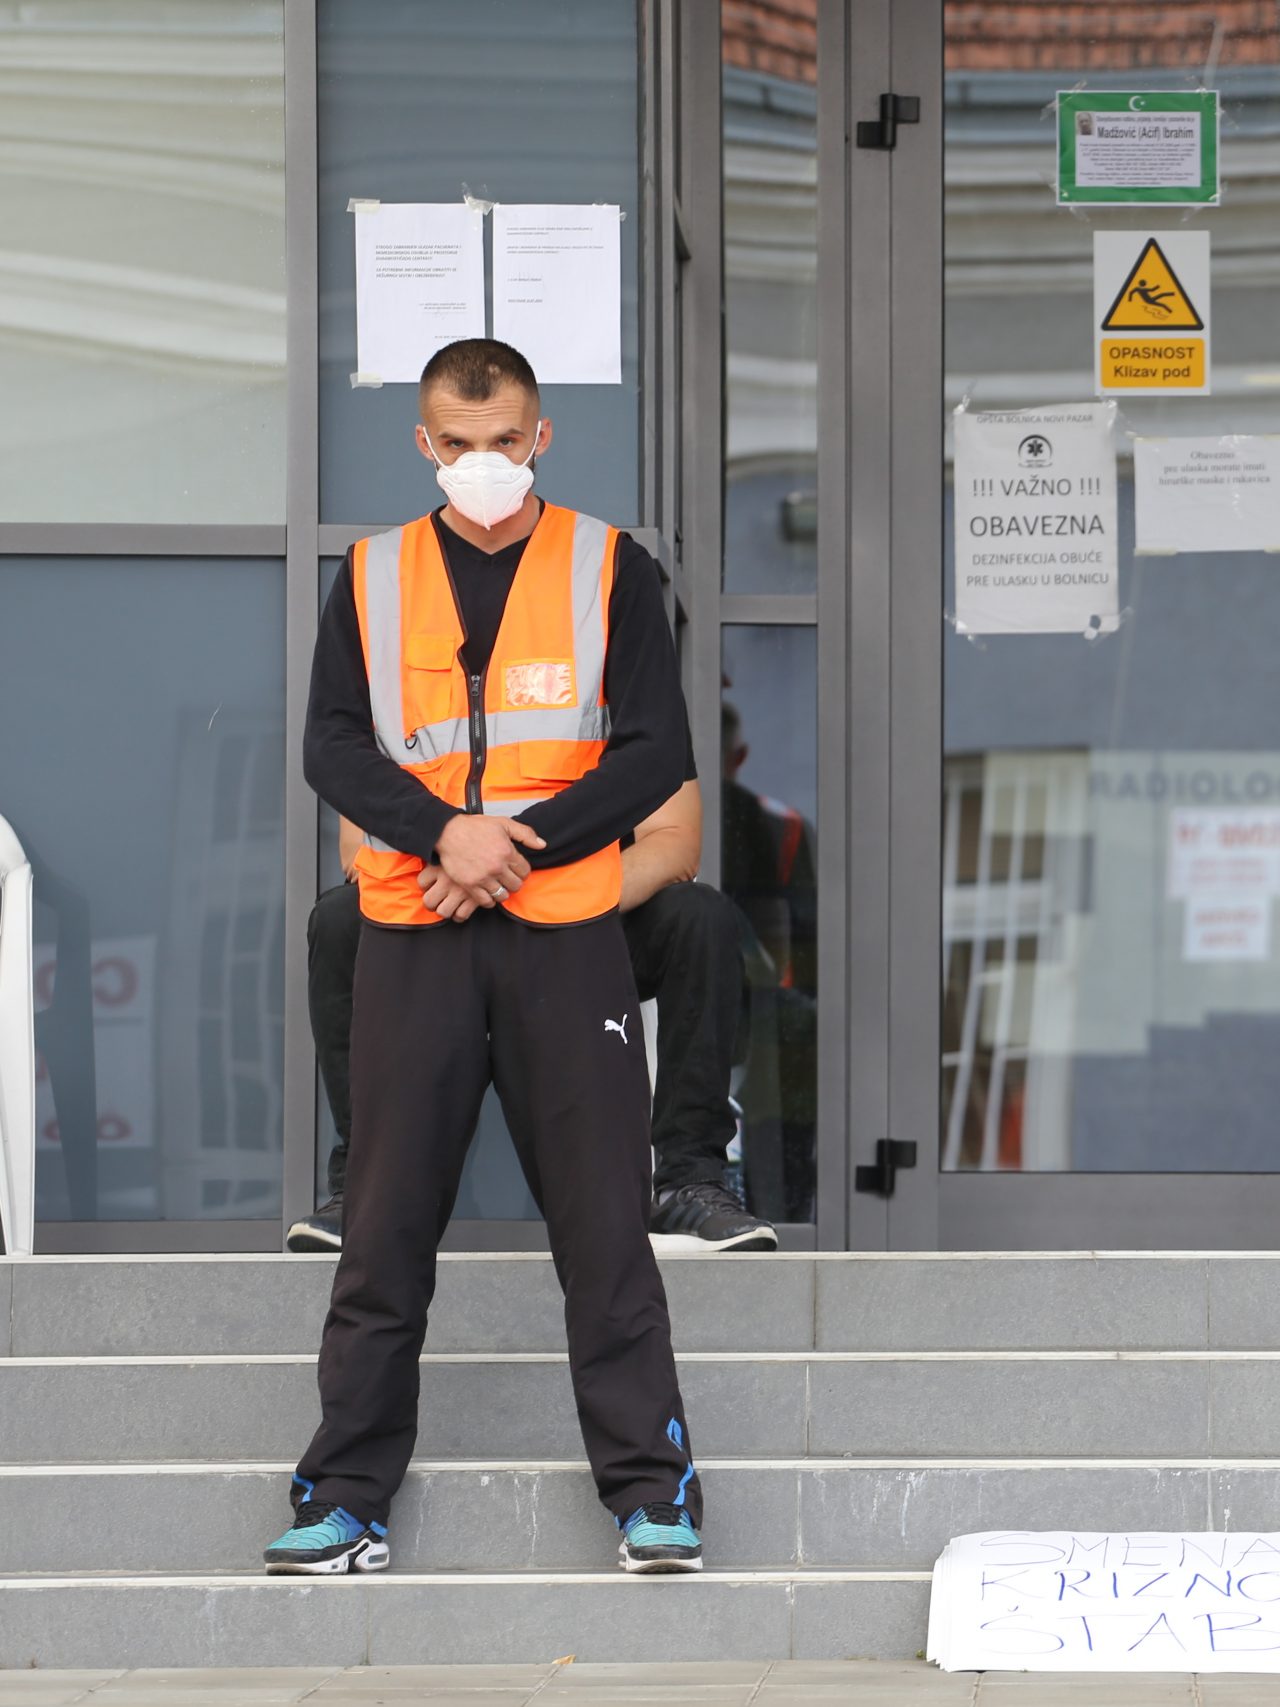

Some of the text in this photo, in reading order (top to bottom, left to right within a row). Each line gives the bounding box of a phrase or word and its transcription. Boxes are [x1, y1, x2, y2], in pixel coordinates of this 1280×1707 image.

[1163, 126, 1194, 139] Ibrahim
[1109, 347, 1195, 360] OPASNOST
[1114, 365, 1191, 380] Klizav pod
[1006, 415, 1041, 424] BOLNICA
[1044, 415, 1065, 423] NOVI
[1067, 414, 1093, 423] PAZAR
[973, 474, 1101, 497] !!! VAŽNO !!!
[969, 515, 1105, 537] OBAVEZNA
[972, 549, 1103, 566] DEZINFEKCIJA OBUĆE
[966, 572, 1109, 587] PRE ULASKU U BOLNICU
